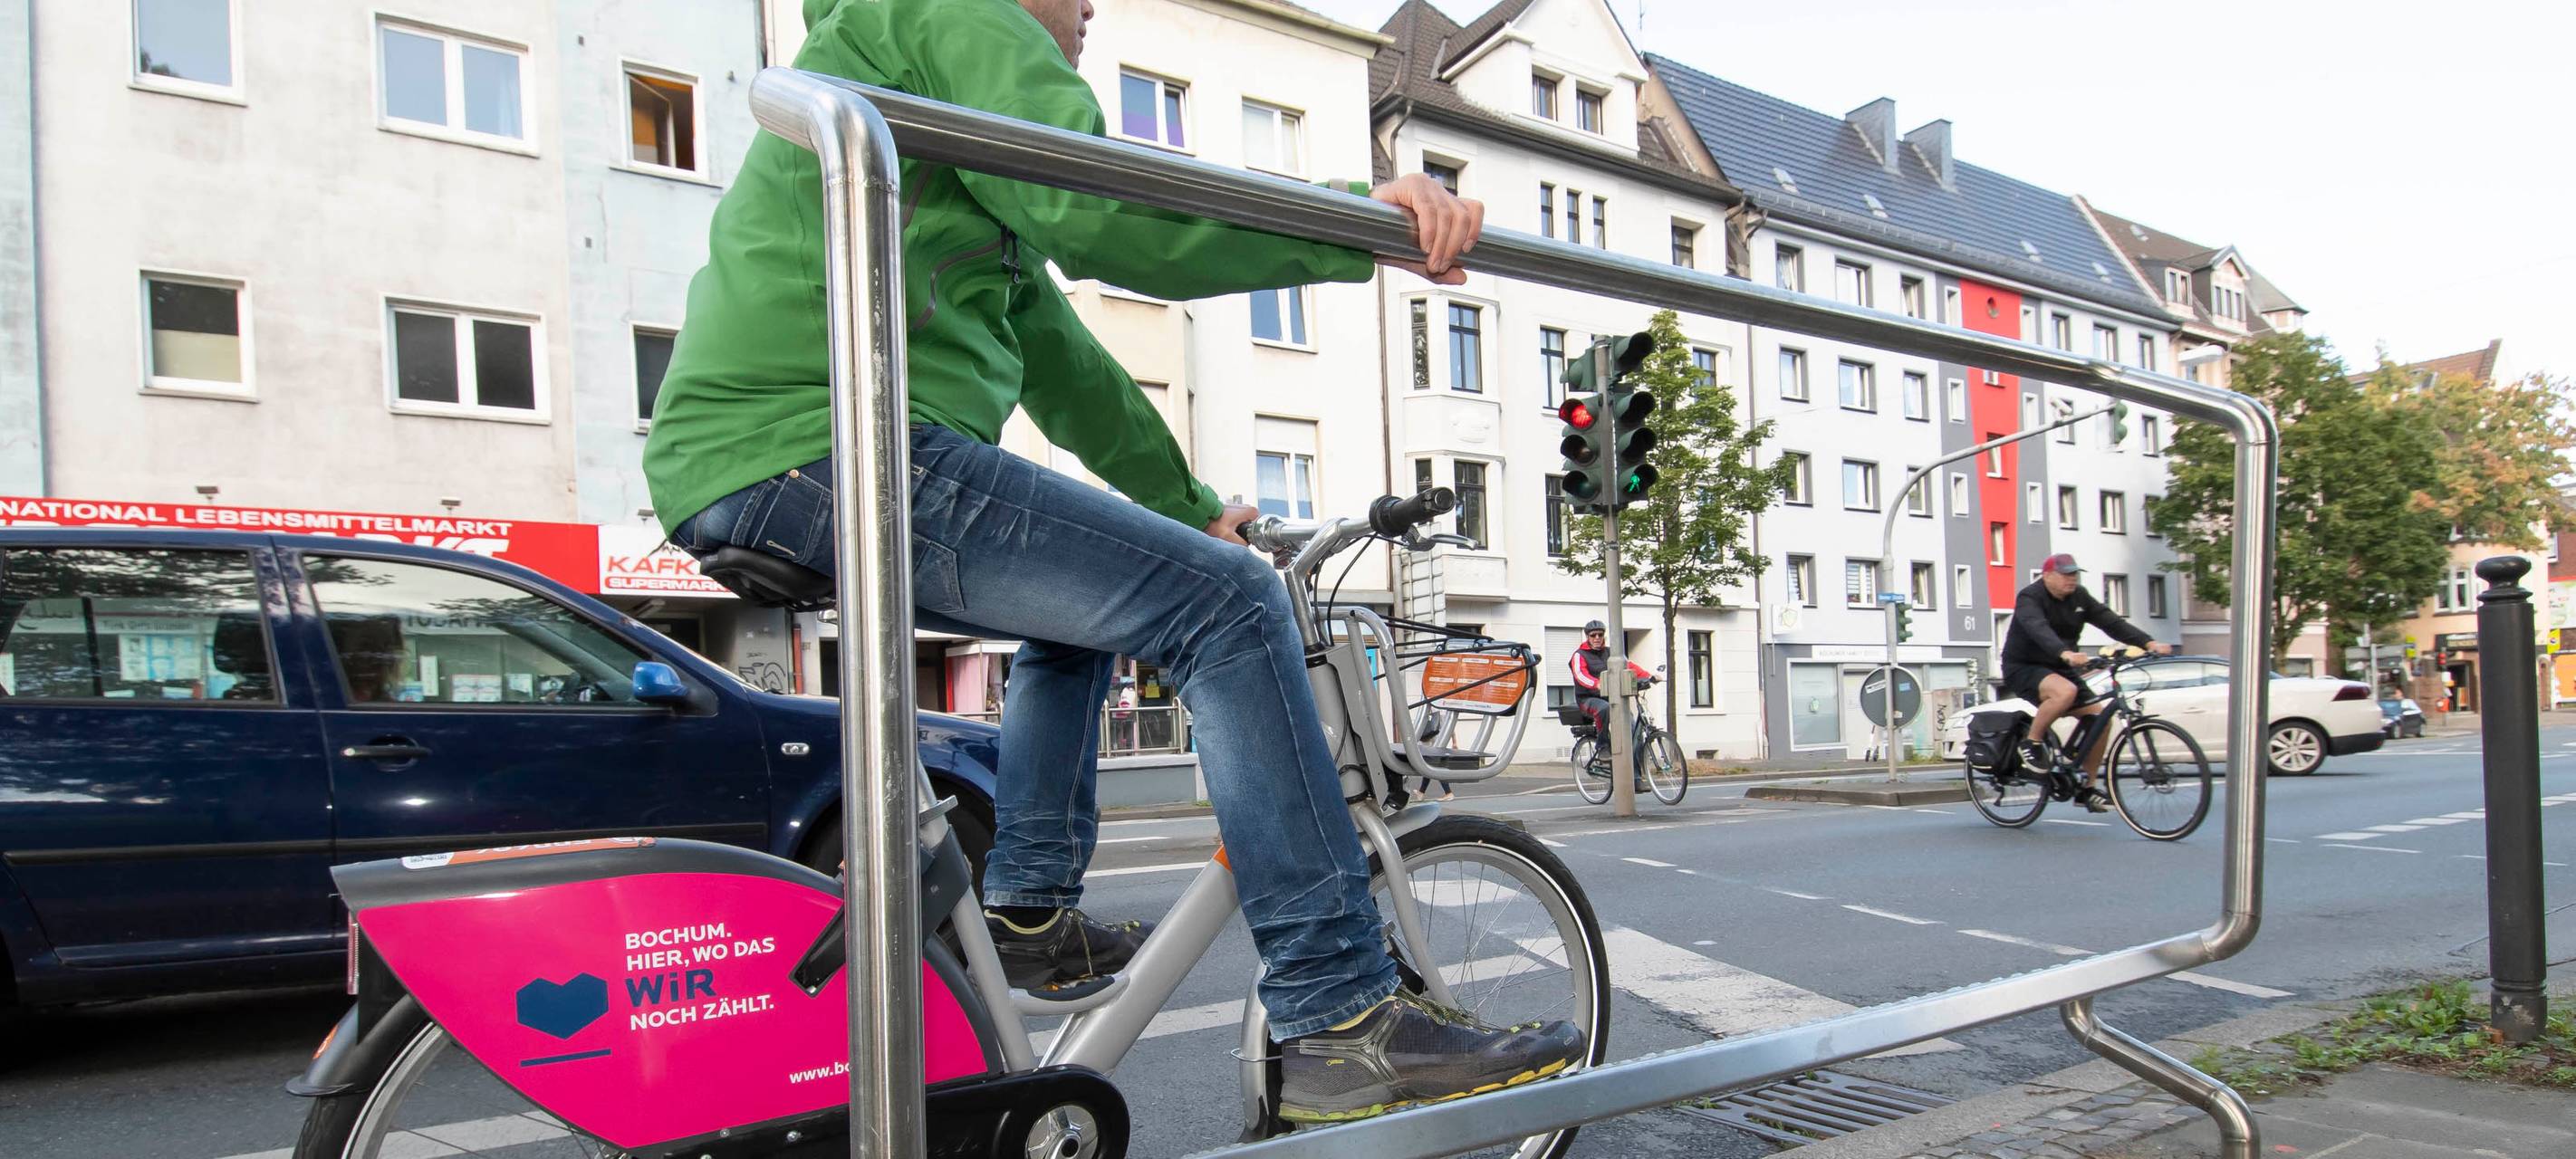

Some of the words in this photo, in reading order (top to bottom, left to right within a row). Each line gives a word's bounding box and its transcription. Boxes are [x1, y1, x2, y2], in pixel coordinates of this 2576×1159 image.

[0, 500, 168, 522] NATIONAL
[176, 508, 514, 536] LEBENSMITTELMARKT
[1965, 616, 1975, 631] 61
[625, 923, 732, 949] BOCHUM.
[627, 949, 689, 972] HIER,
[692, 943, 728, 963] WO
[734, 937, 775, 957] DAS
[625, 968, 716, 1008] WiR
[630, 1006, 697, 1030] NOCH
[703, 994, 774, 1020] ZÄHLT.
